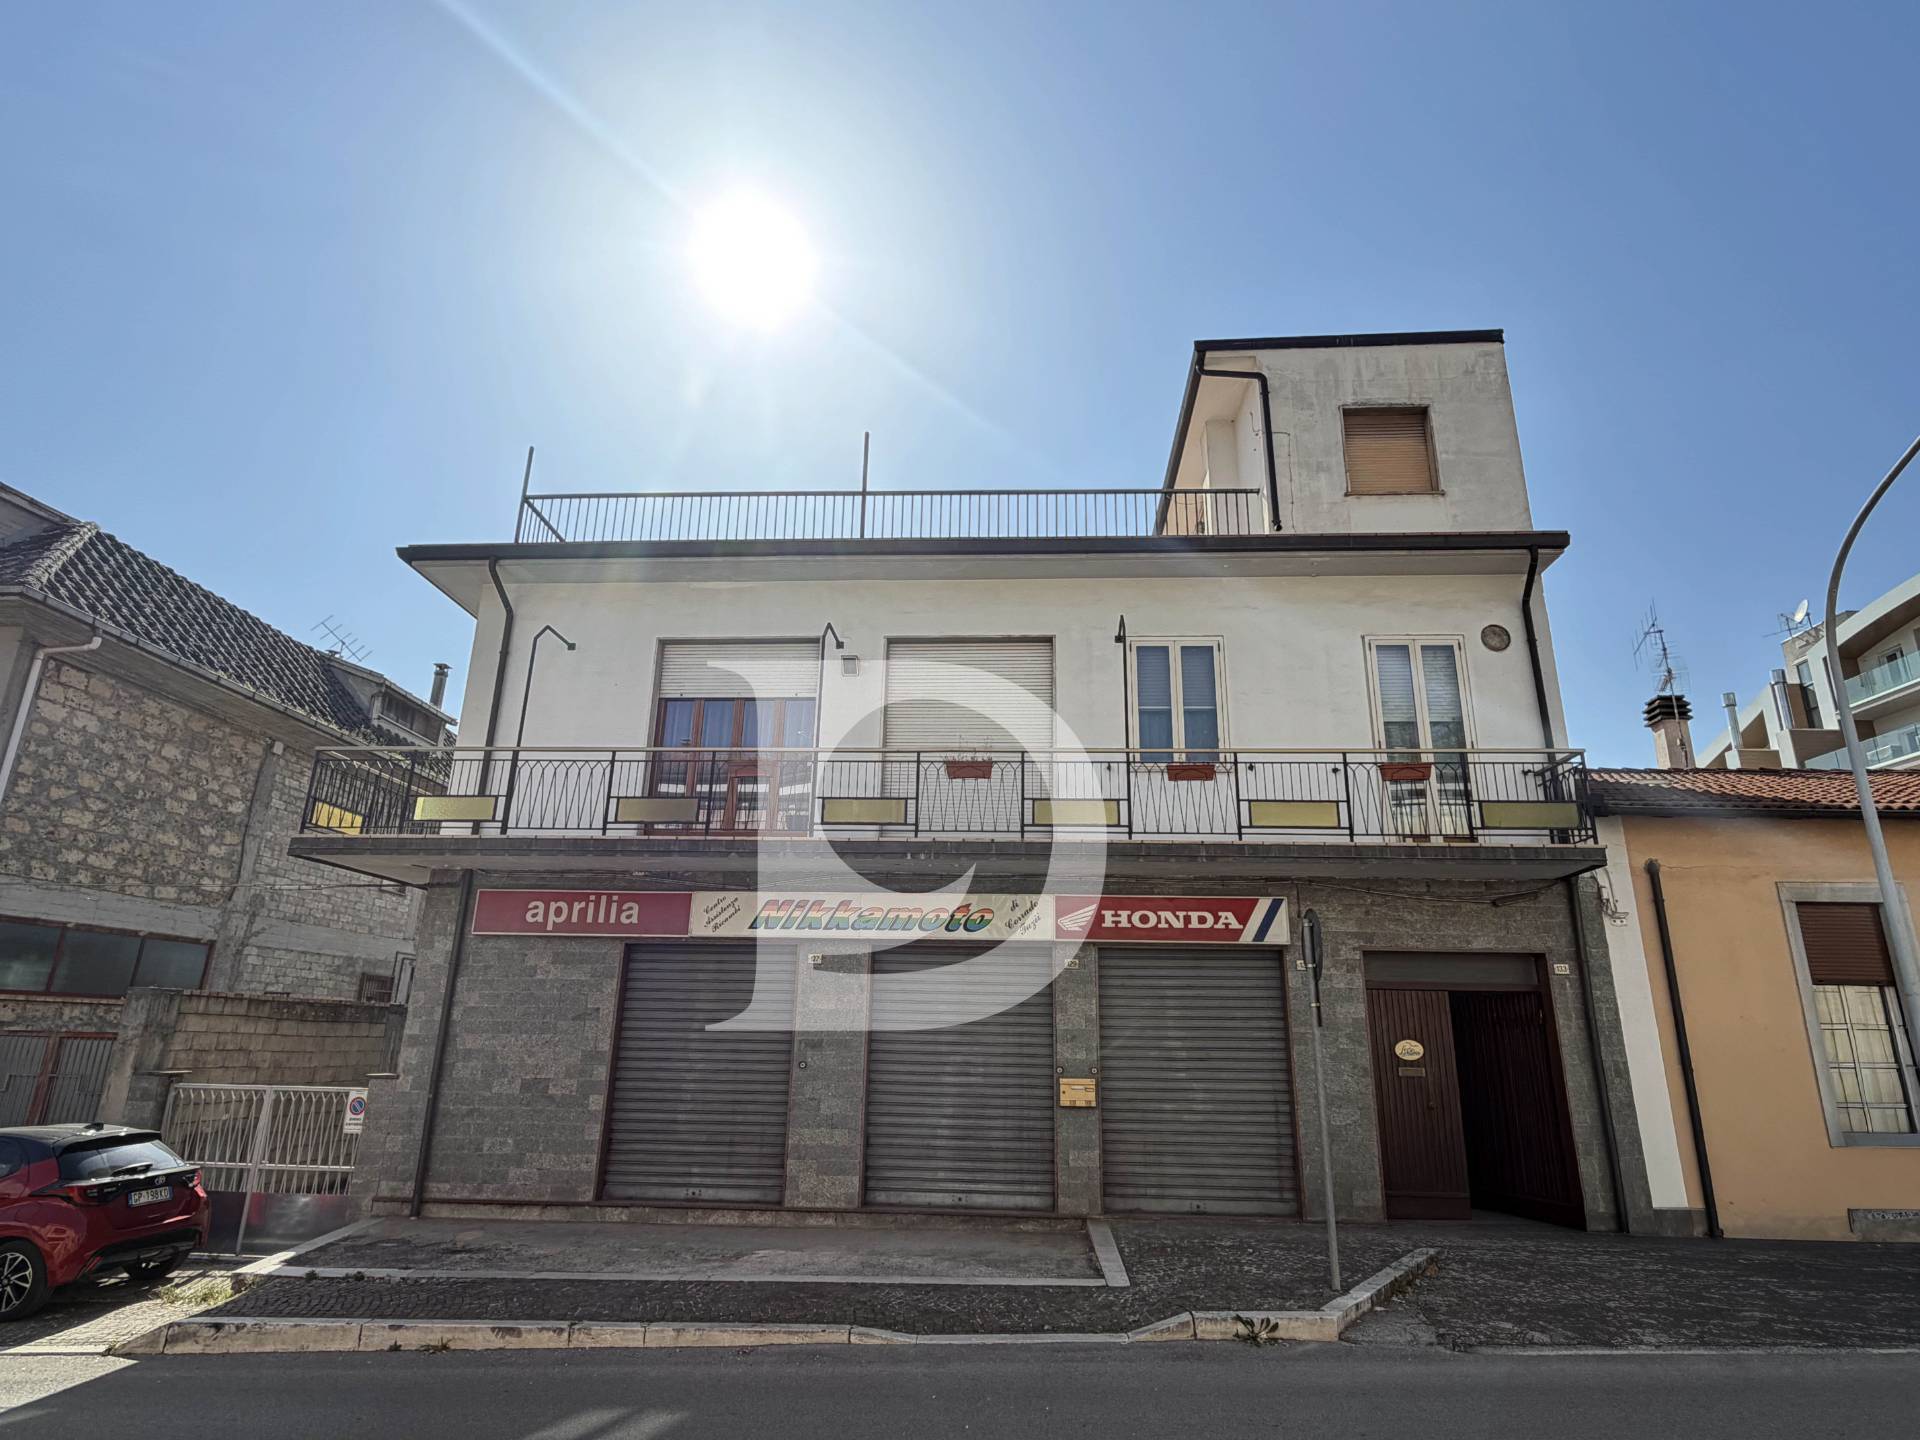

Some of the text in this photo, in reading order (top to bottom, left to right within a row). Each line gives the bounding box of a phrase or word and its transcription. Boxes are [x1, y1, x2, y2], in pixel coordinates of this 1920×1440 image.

[525, 894, 640, 931] aprilia
[703, 895, 727, 914] Centro
[703, 896, 739, 928] Assistenza
[711, 904, 741, 933] Ricambi
[748, 899, 995, 933] Nikkamoto
[1004, 899, 1039, 930] Corrado
[1010, 898, 1020, 912] di
[1101, 910, 1244, 929] HONDA
